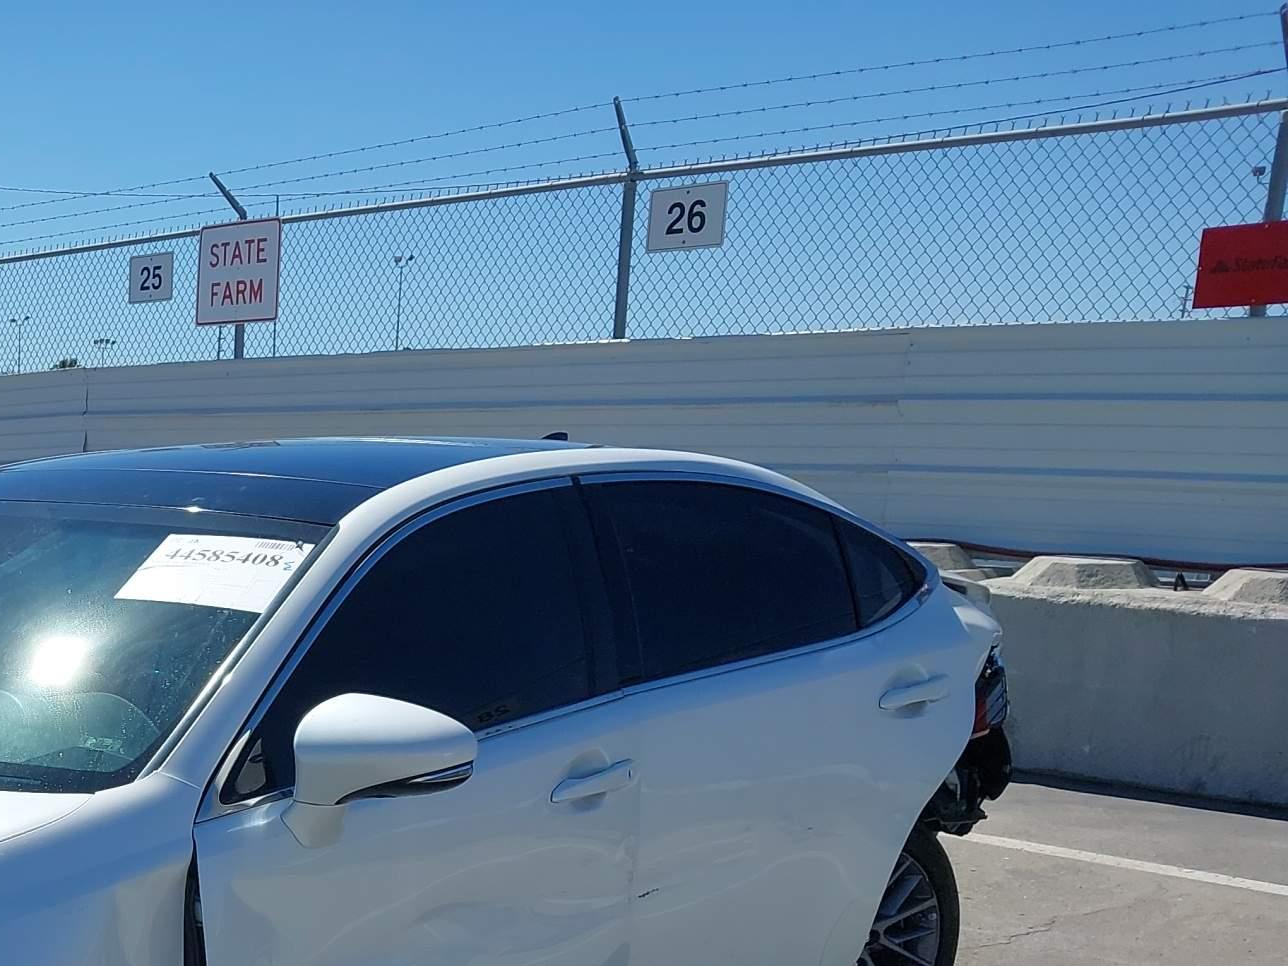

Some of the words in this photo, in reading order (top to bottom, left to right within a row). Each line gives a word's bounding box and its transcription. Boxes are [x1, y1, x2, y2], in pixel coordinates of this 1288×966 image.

[665, 199, 706, 235] 26
[209, 237, 268, 268] STATE
[140, 265, 162, 291] 25
[210, 278, 263, 307] FARM
[165, 548, 284, 568] 44585408
